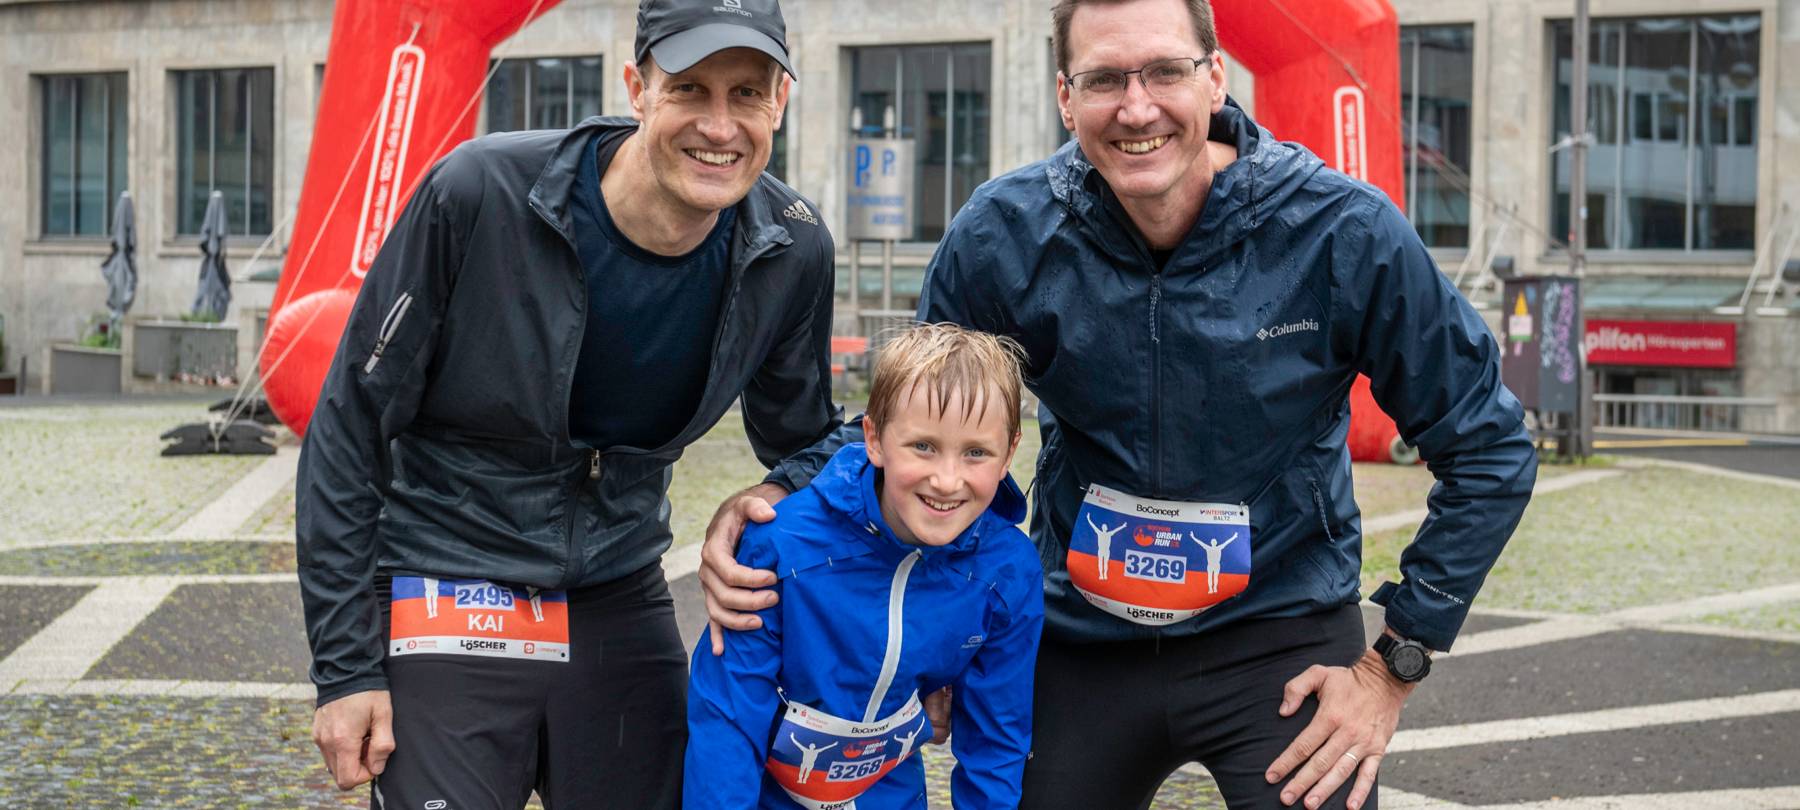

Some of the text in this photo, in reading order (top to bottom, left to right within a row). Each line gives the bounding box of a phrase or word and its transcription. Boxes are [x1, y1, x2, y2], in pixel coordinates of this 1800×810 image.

[783, 209, 818, 226] adidas
[1269, 318, 1319, 338] Columbia
[1136, 504, 1180, 518] BoConcept
[1154, 538, 1170, 548] RUN
[1156, 531, 1183, 541] URBAN
[1126, 554, 1185, 580] 3269
[456, 585, 513, 608] 2495
[1127, 607, 1174, 620] LÖSCHER
[467, 613, 503, 632] KAI
[460, 639, 507, 651] LÖSCHER
[828, 759, 883, 781] 3268
